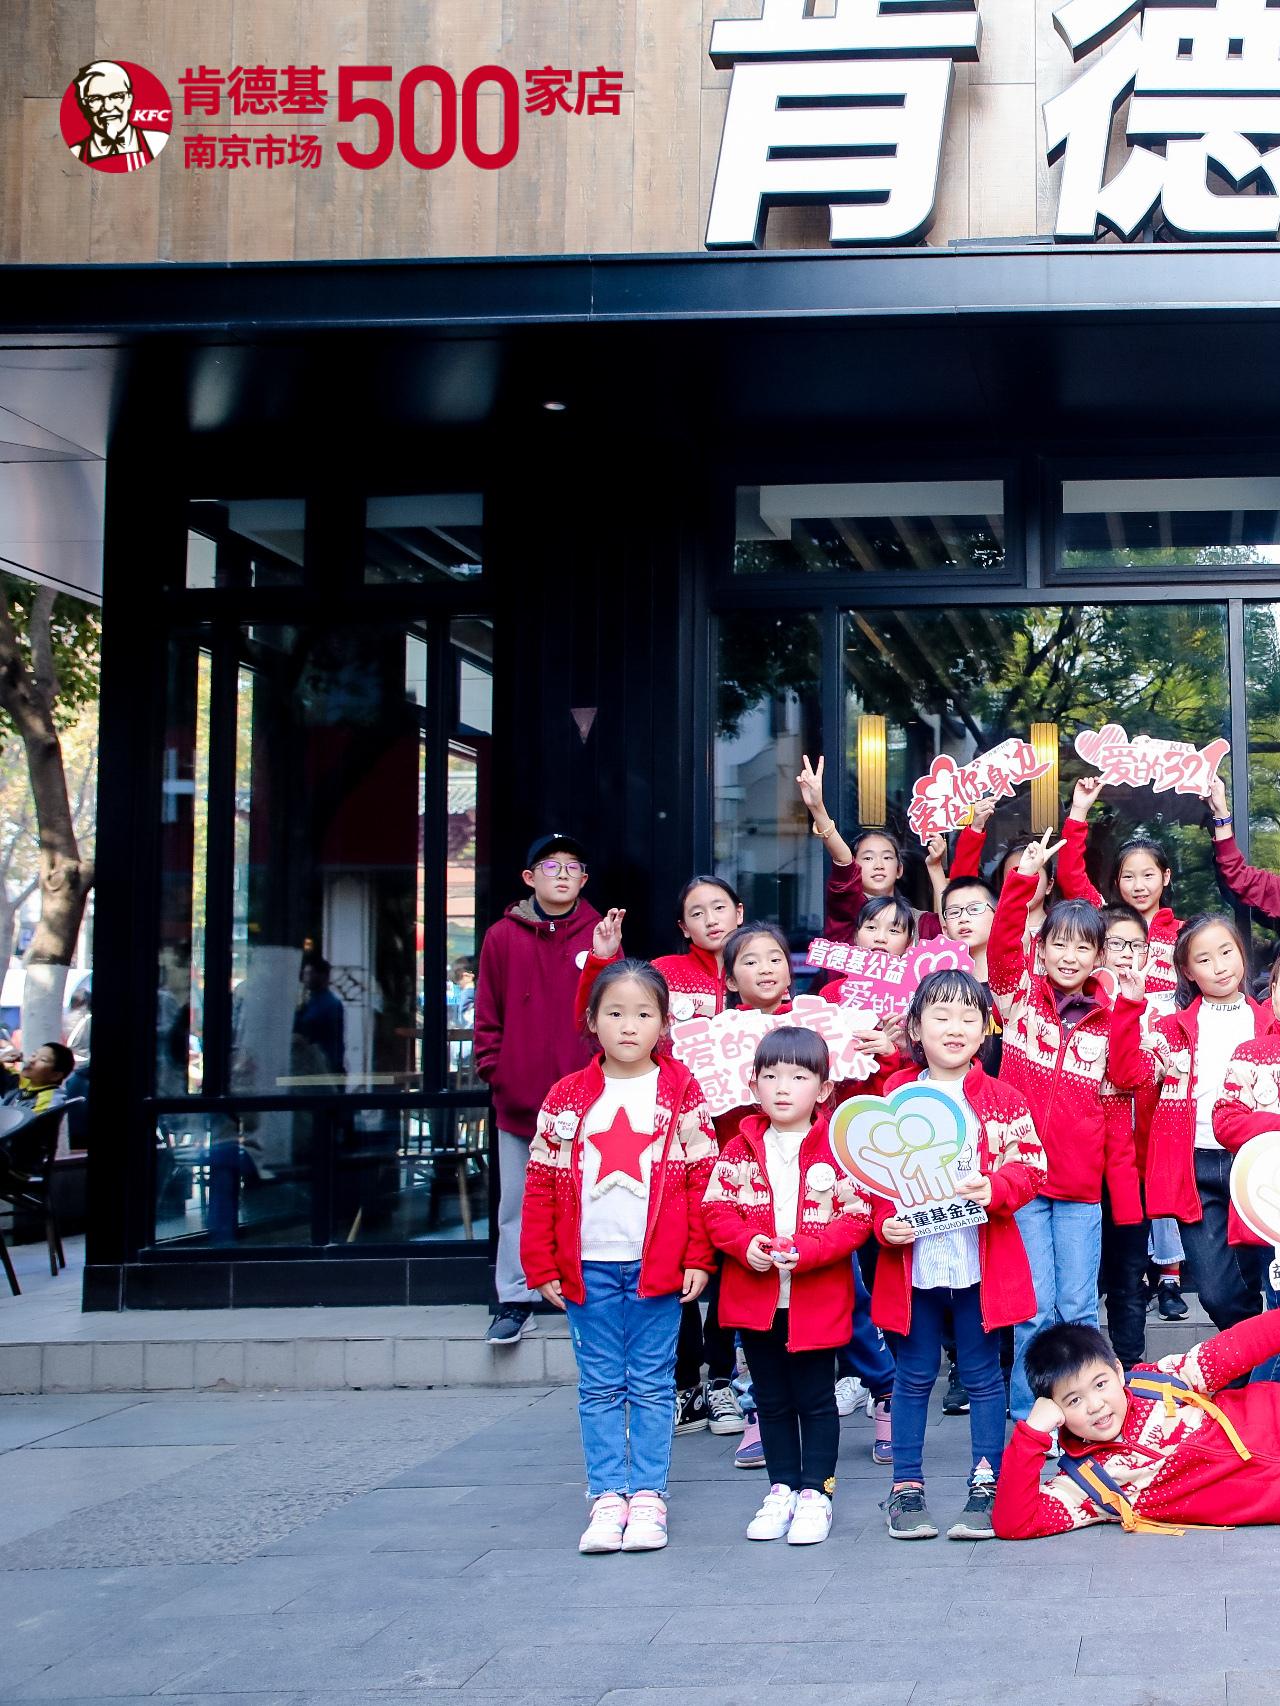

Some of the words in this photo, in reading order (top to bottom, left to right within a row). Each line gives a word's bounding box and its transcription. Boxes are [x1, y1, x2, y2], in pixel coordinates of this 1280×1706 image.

[908, 740, 1051, 844] 爱在你身边
[1101, 740, 1229, 795] 爱的321
[808, 940, 908, 985] 肯德基公益
[673, 997, 844, 1071] 爱的定
[933, 1215, 986, 1233] FOUNDATION
